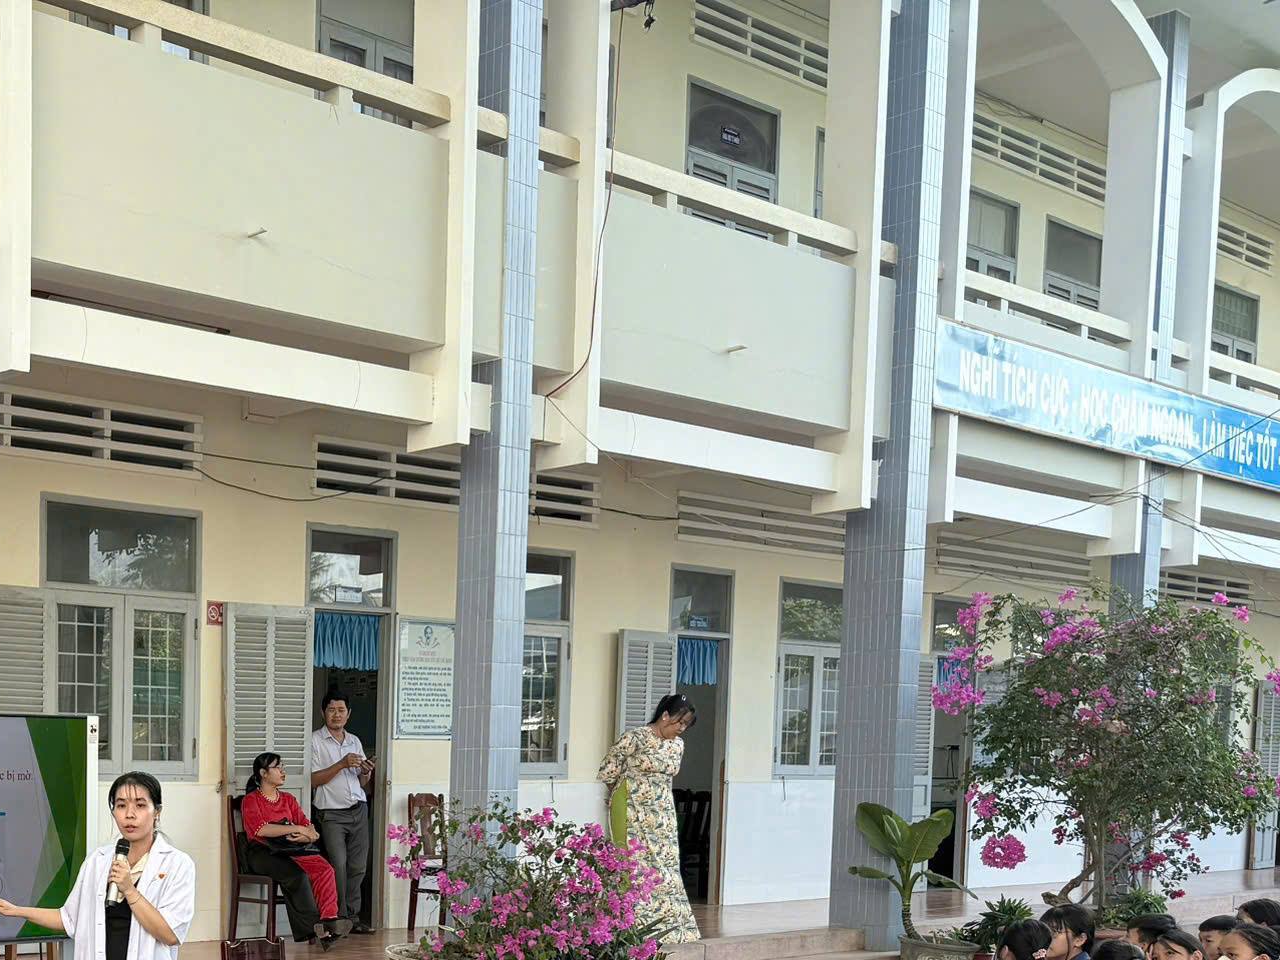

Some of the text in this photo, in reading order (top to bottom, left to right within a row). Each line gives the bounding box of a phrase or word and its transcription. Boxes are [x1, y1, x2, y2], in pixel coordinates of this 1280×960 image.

[1202, 410, 1226, 459] LÀM
[1229, 420, 1254, 474] VIỆC
[1257, 421, 1278, 471] TỐT
[7, 769, 15, 782] bị
